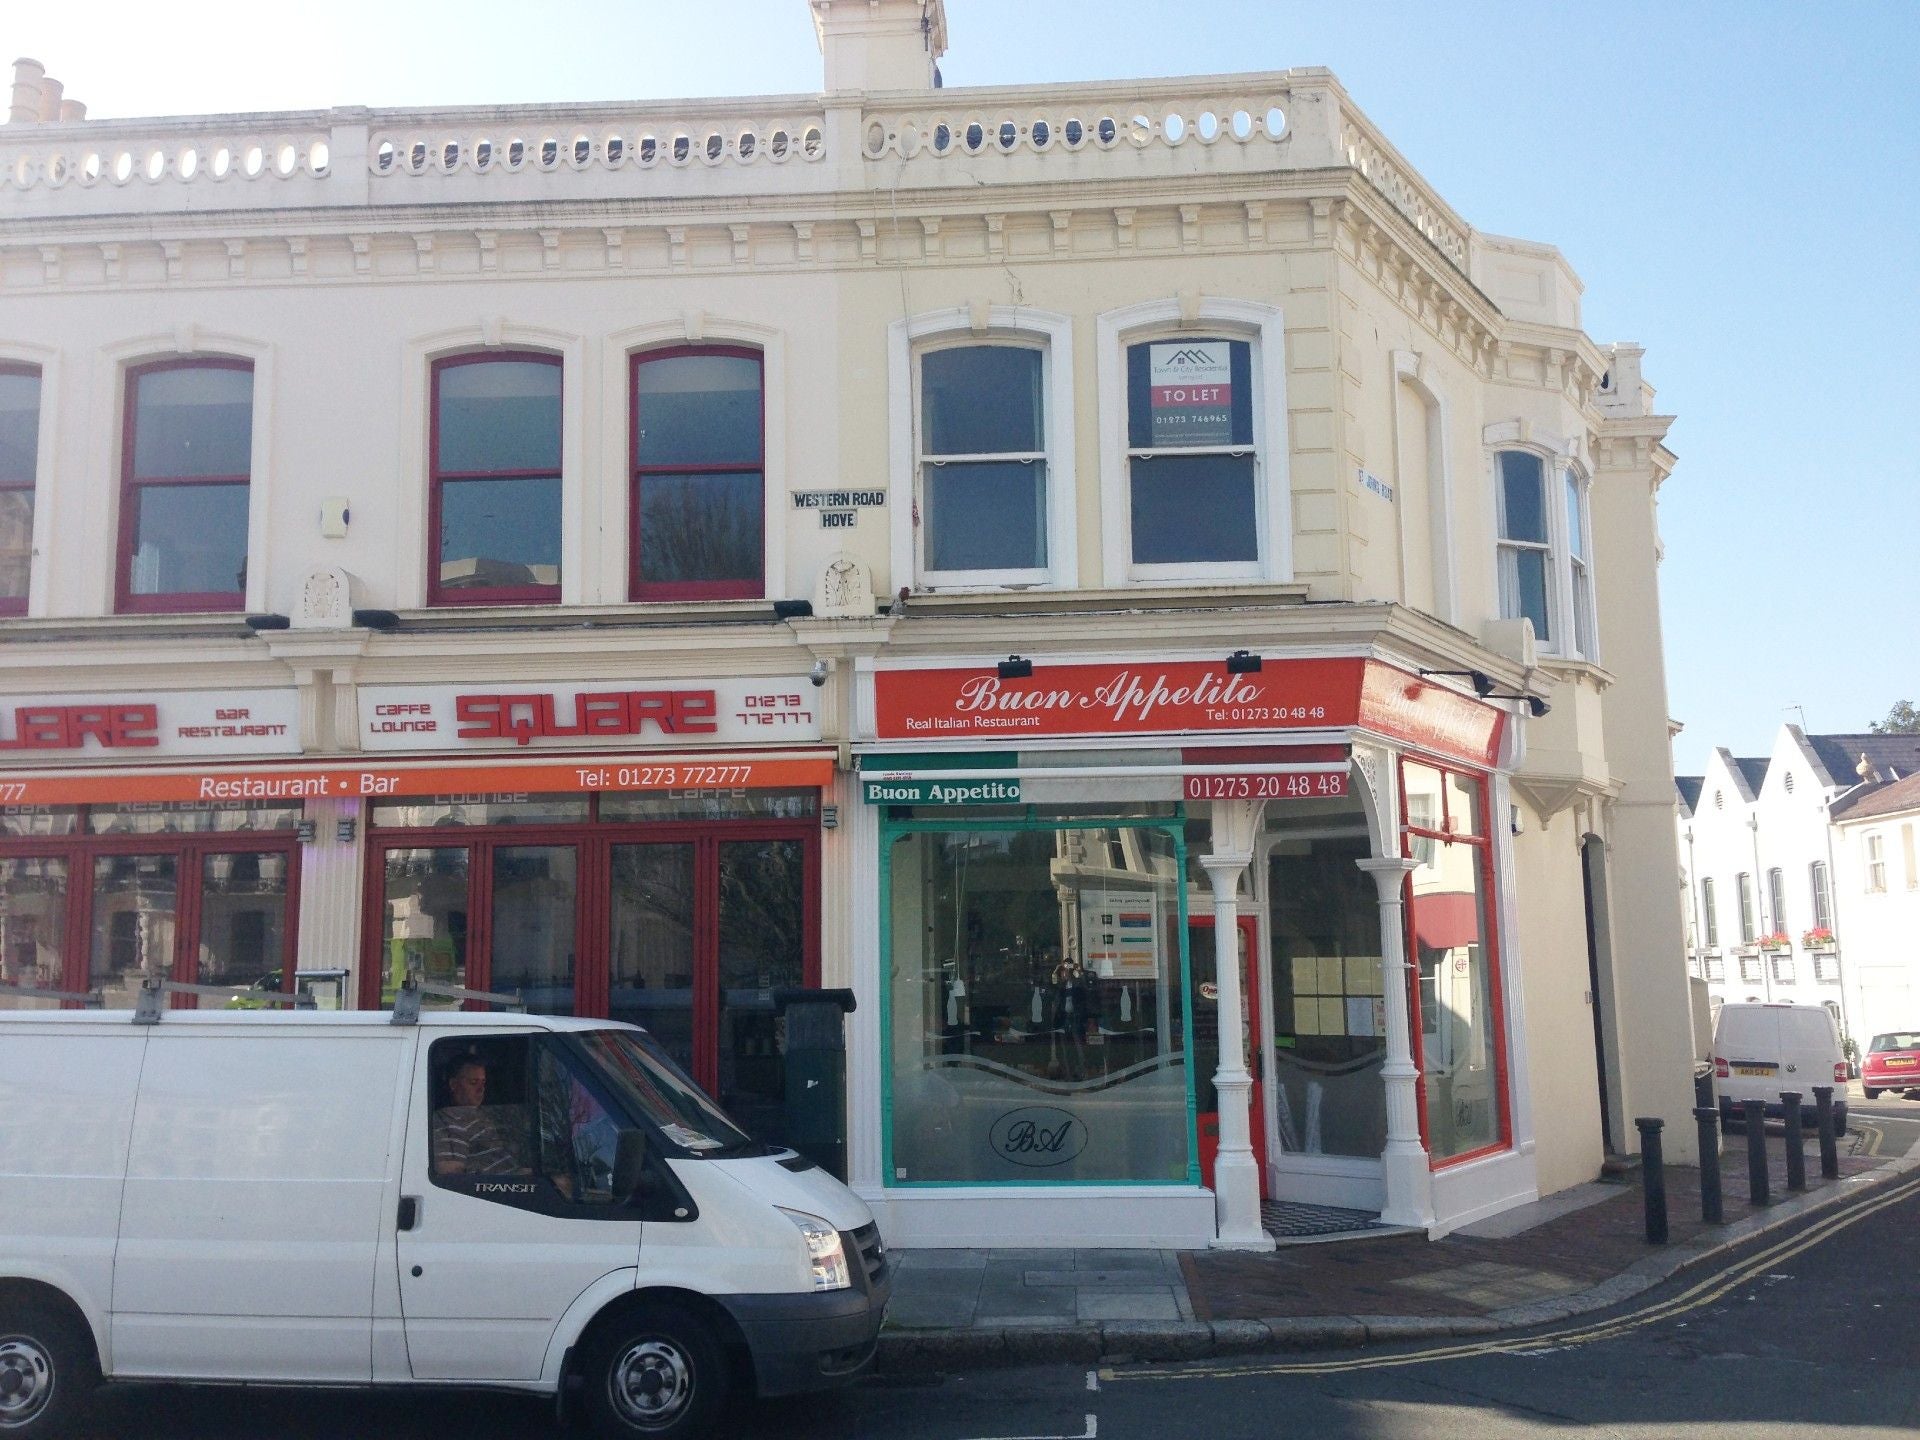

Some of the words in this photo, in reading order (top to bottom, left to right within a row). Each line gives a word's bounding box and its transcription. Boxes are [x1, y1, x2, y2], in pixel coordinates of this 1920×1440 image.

[1163, 390, 1186, 402] TO
[1192, 388, 1219, 401] LET
[1156, 416, 1186, 424] 01273
[794, 493, 850, 507] WESTERN
[852, 492, 884, 506] ROAD
[822, 513, 854, 527] HOVE
[745, 695, 801, 707] 01273
[955, 675, 1081, 711] Buon
[1079, 671, 1265, 722] Appetito
[736, 712, 812, 725] 772777
[1206, 708, 1229, 720] Tel:
[1232, 708, 1269, 720] 01273
[1272, 707, 1288, 719] 20
[1290, 706, 1306, 718] 48
[1309, 706, 1325, 718] 48
[906, 717, 932, 730] Real
[935, 716, 970, 729] Italian
[974, 715, 1040, 727] Restaurant
[576, 769, 610, 786] Tel:
[618, 768, 676, 786] 01273
[682, 766, 752, 784] 772777
[199, 777, 328, 798] Restaurant
[360, 773, 399, 793] Bar
[868, 784, 920, 800] Buon
[928, 782, 1020, 803] Appetito
[1190, 777, 1249, 797] 01273
[1256, 776, 1280, 795] 20
[1287, 775, 1311, 795] 48
[1318, 774, 1341, 794] 48
[1006, 1120, 1072, 1152] BA
[475, 1183, 537, 1193] TRANSIT
